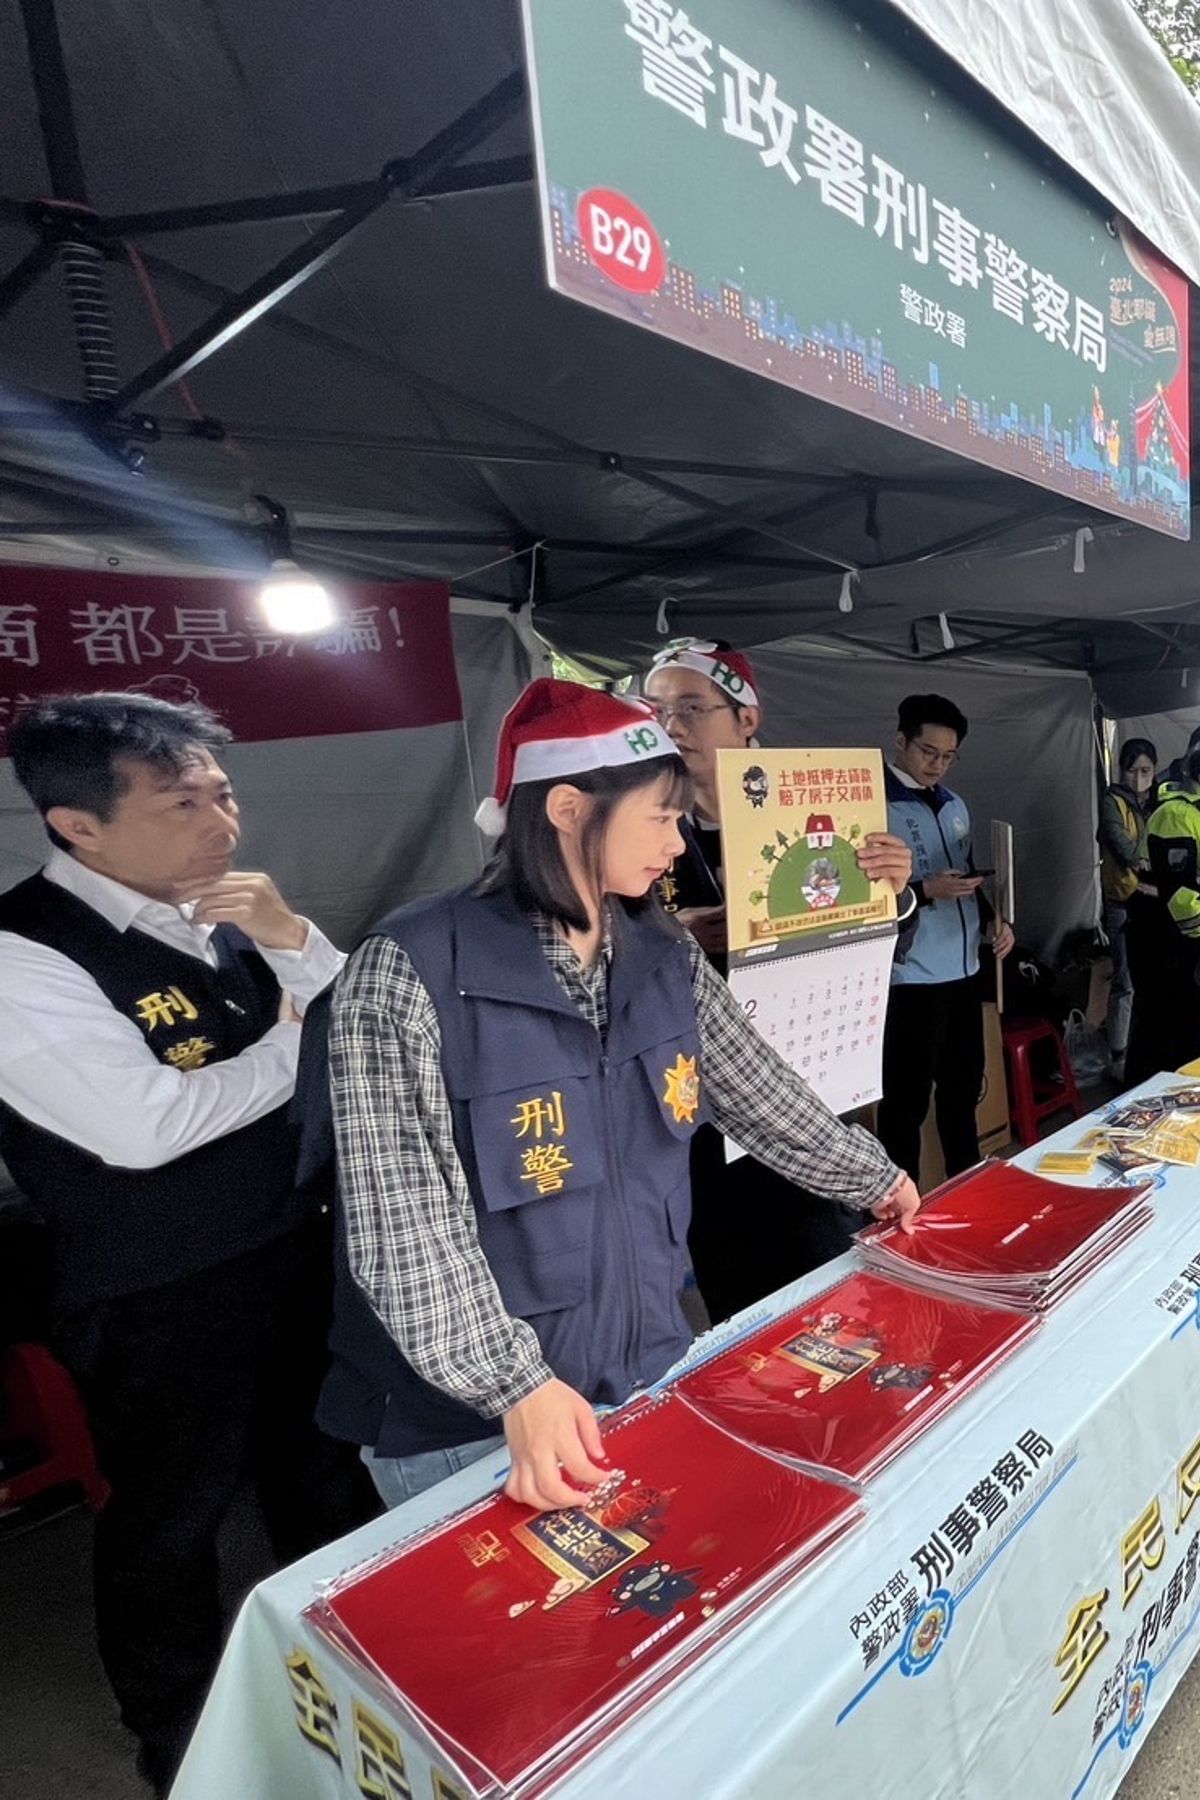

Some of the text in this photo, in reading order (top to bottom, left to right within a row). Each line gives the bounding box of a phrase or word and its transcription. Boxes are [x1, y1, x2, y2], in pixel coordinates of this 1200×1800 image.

[624, 0, 1108, 373] 警政署刑事警察局
[590, 204, 652, 274] B29
[900, 284, 967, 349] 警政署
[711, 662, 745, 694] HO
[135, 986, 215, 1073] 刑警
[510, 1091, 573, 1193] 刑警
[910, 1428, 1054, 1597] 刑事警察局
[849, 1569, 909, 1639] 內政部
[861, 1587, 922, 1672] 警政署
